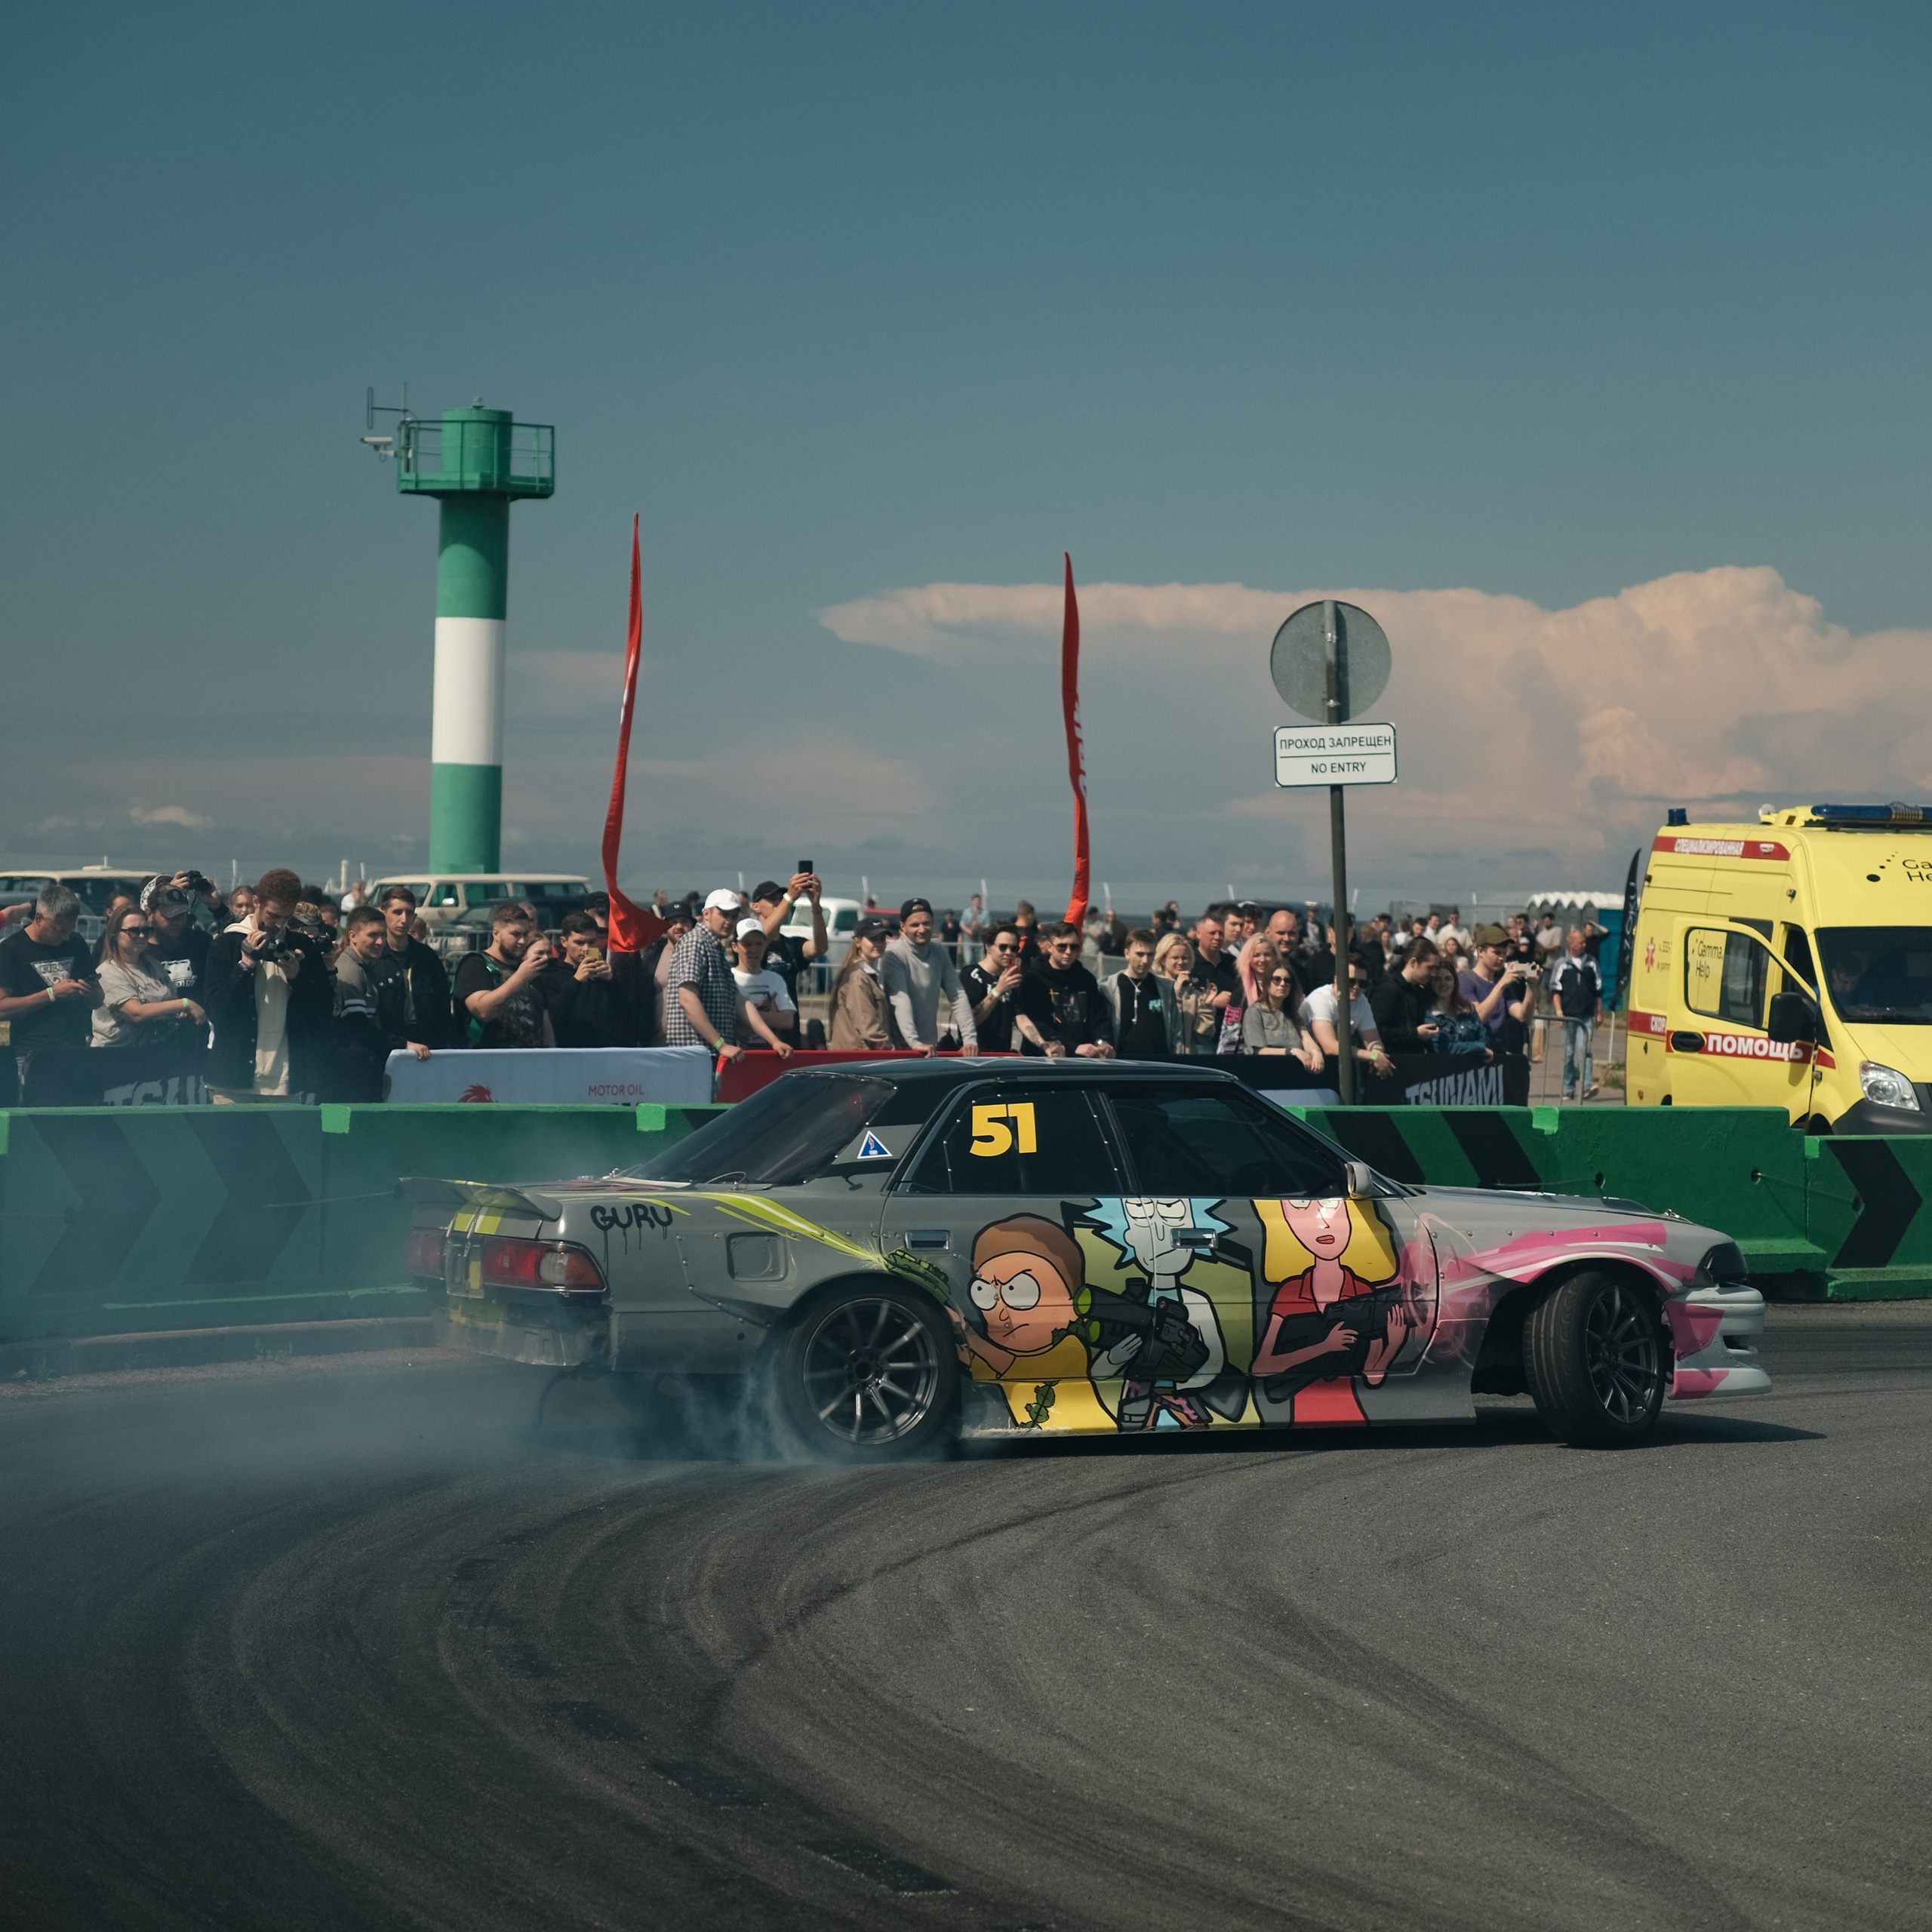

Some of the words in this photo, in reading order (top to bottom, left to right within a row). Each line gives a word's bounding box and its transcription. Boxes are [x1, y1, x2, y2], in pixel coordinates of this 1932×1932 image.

[1280, 737, 1326, 749] ПРОХОД
[1329, 735, 1392, 748] ЗАПРЕЩЕН
[1311, 763, 1327, 774] NO
[1331, 761, 1367, 773] ENTRY
[1696, 960, 1710, 983] Help
[1707, 1034, 1804, 1062] ПОМОЩЬ
[589, 1084, 625, 1097] MOTOR
[627, 1083, 645, 1096] OIL
[970, 1103, 1037, 1157] 51
[590, 1203, 673, 1240] GURU
